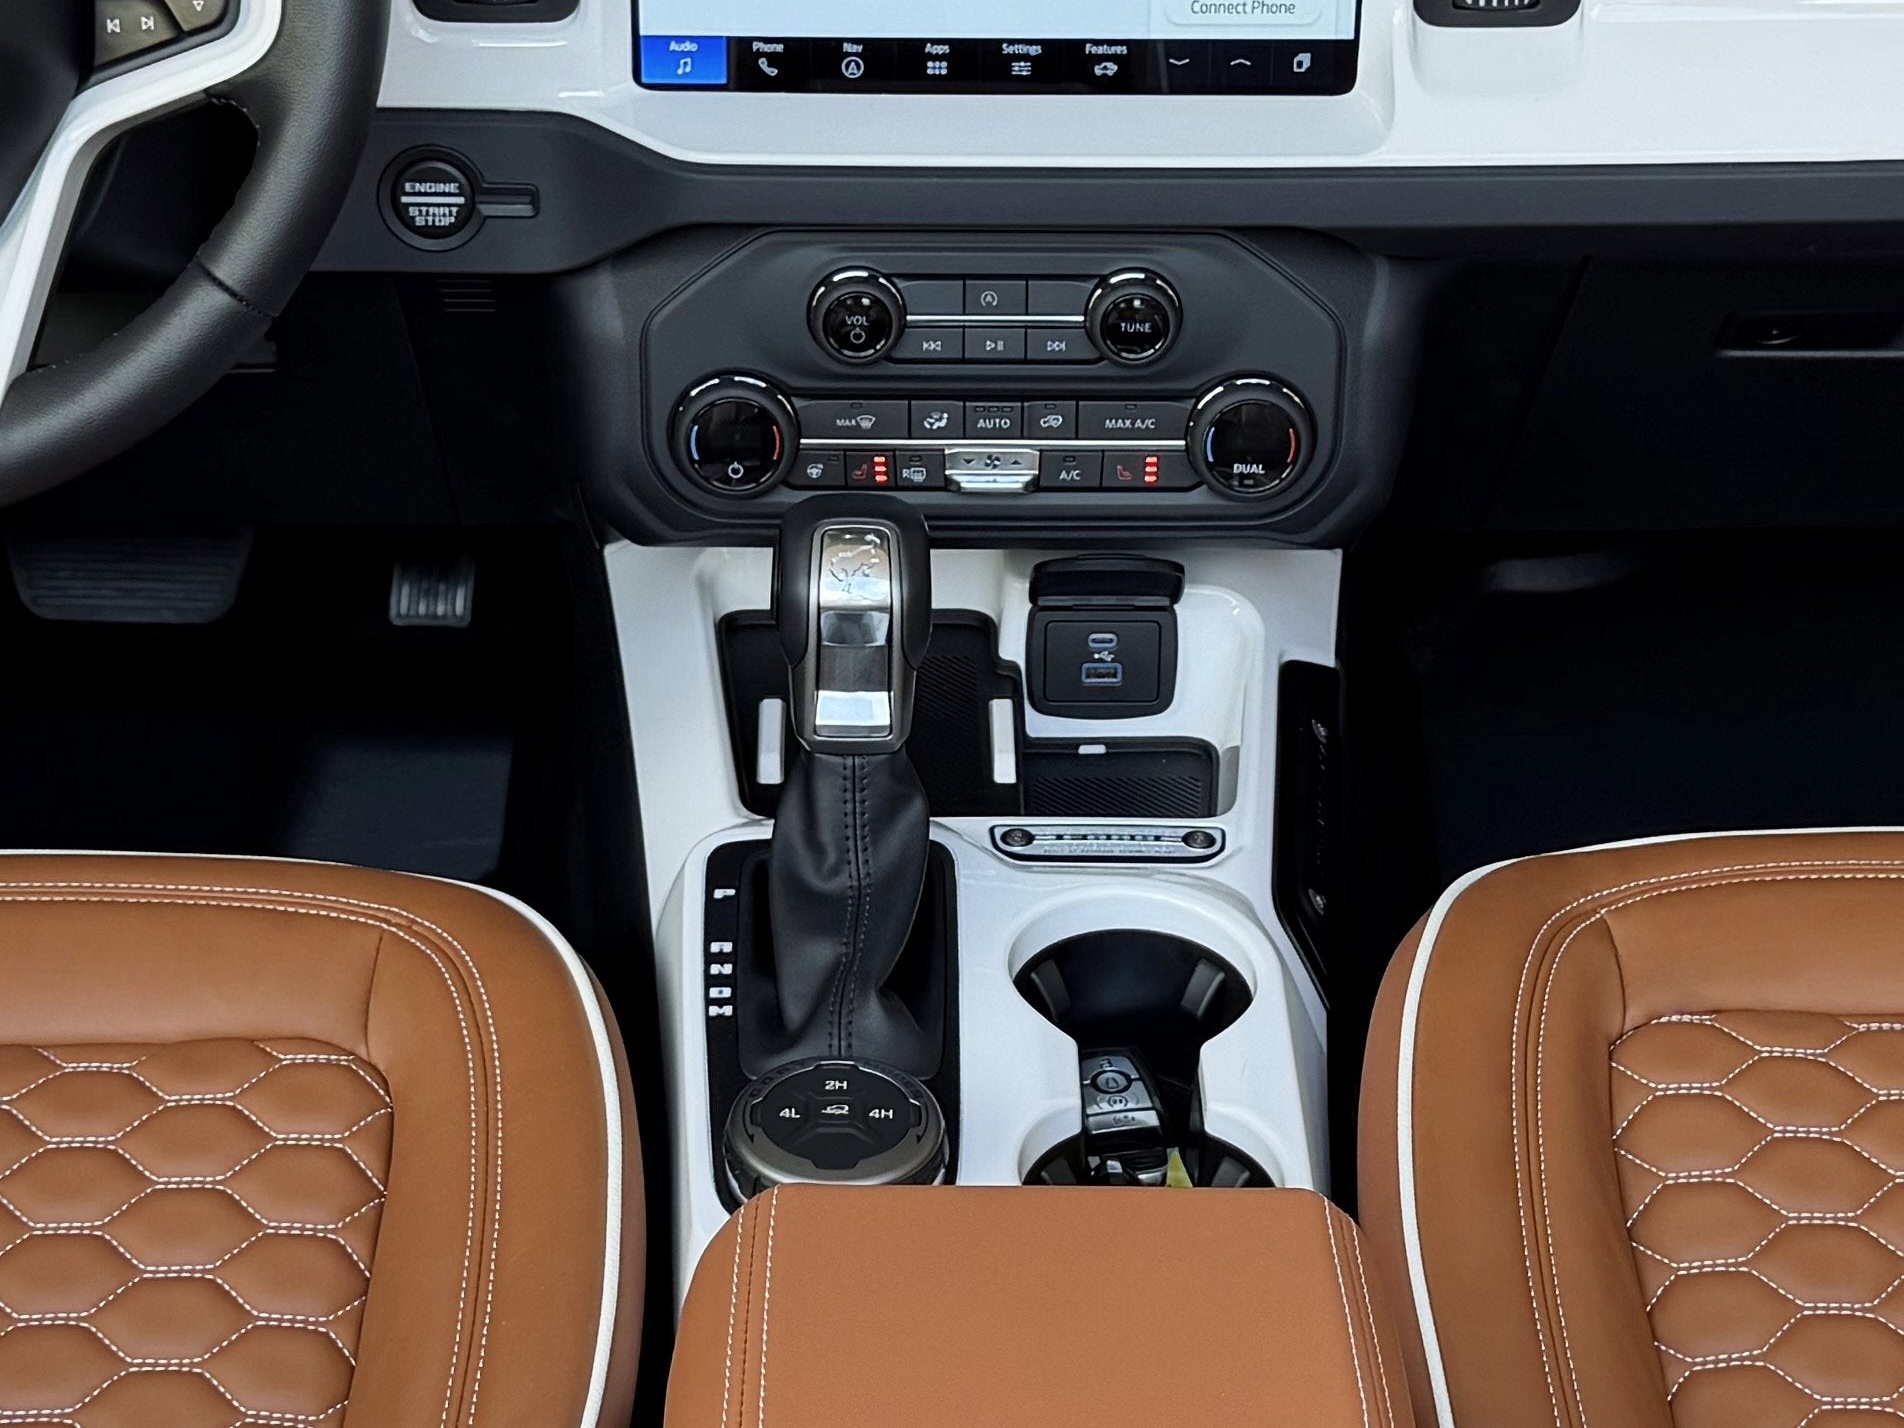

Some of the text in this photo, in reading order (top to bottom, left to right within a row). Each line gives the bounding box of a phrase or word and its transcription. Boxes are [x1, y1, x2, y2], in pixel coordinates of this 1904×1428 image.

[1191, 0, 1296, 14] Connect Phone
[669, 41, 698, 54] Audio
[752, 42, 784, 53] Phone
[842, 42, 863, 53] Nav
[925, 43, 950, 55] Apps
[1001, 43, 1042, 56] Settings
[1085, 43, 1127, 55] Features
[404, 182, 460, 194] ENGINE
[408, 206, 459, 217] START
[415, 217, 455, 226] STOP
[845, 315, 869, 327] VOL
[1120, 322, 1152, 333] TUNE
[836, 417, 857, 427] MAX
[977, 417, 1011, 429] AUTO
[1105, 417, 1156, 430] MAX A/C
[1233, 463, 1265, 474] DUAL
[1059, 469, 1081, 482] A/C
[713, 888, 736, 899] P
[709, 963, 733, 975] N
[708, 1004, 733, 1017] M
[824, 1080, 848, 1090] 2H
[779, 1108, 800, 1119] 4L
[868, 1108, 894, 1120] 4H
